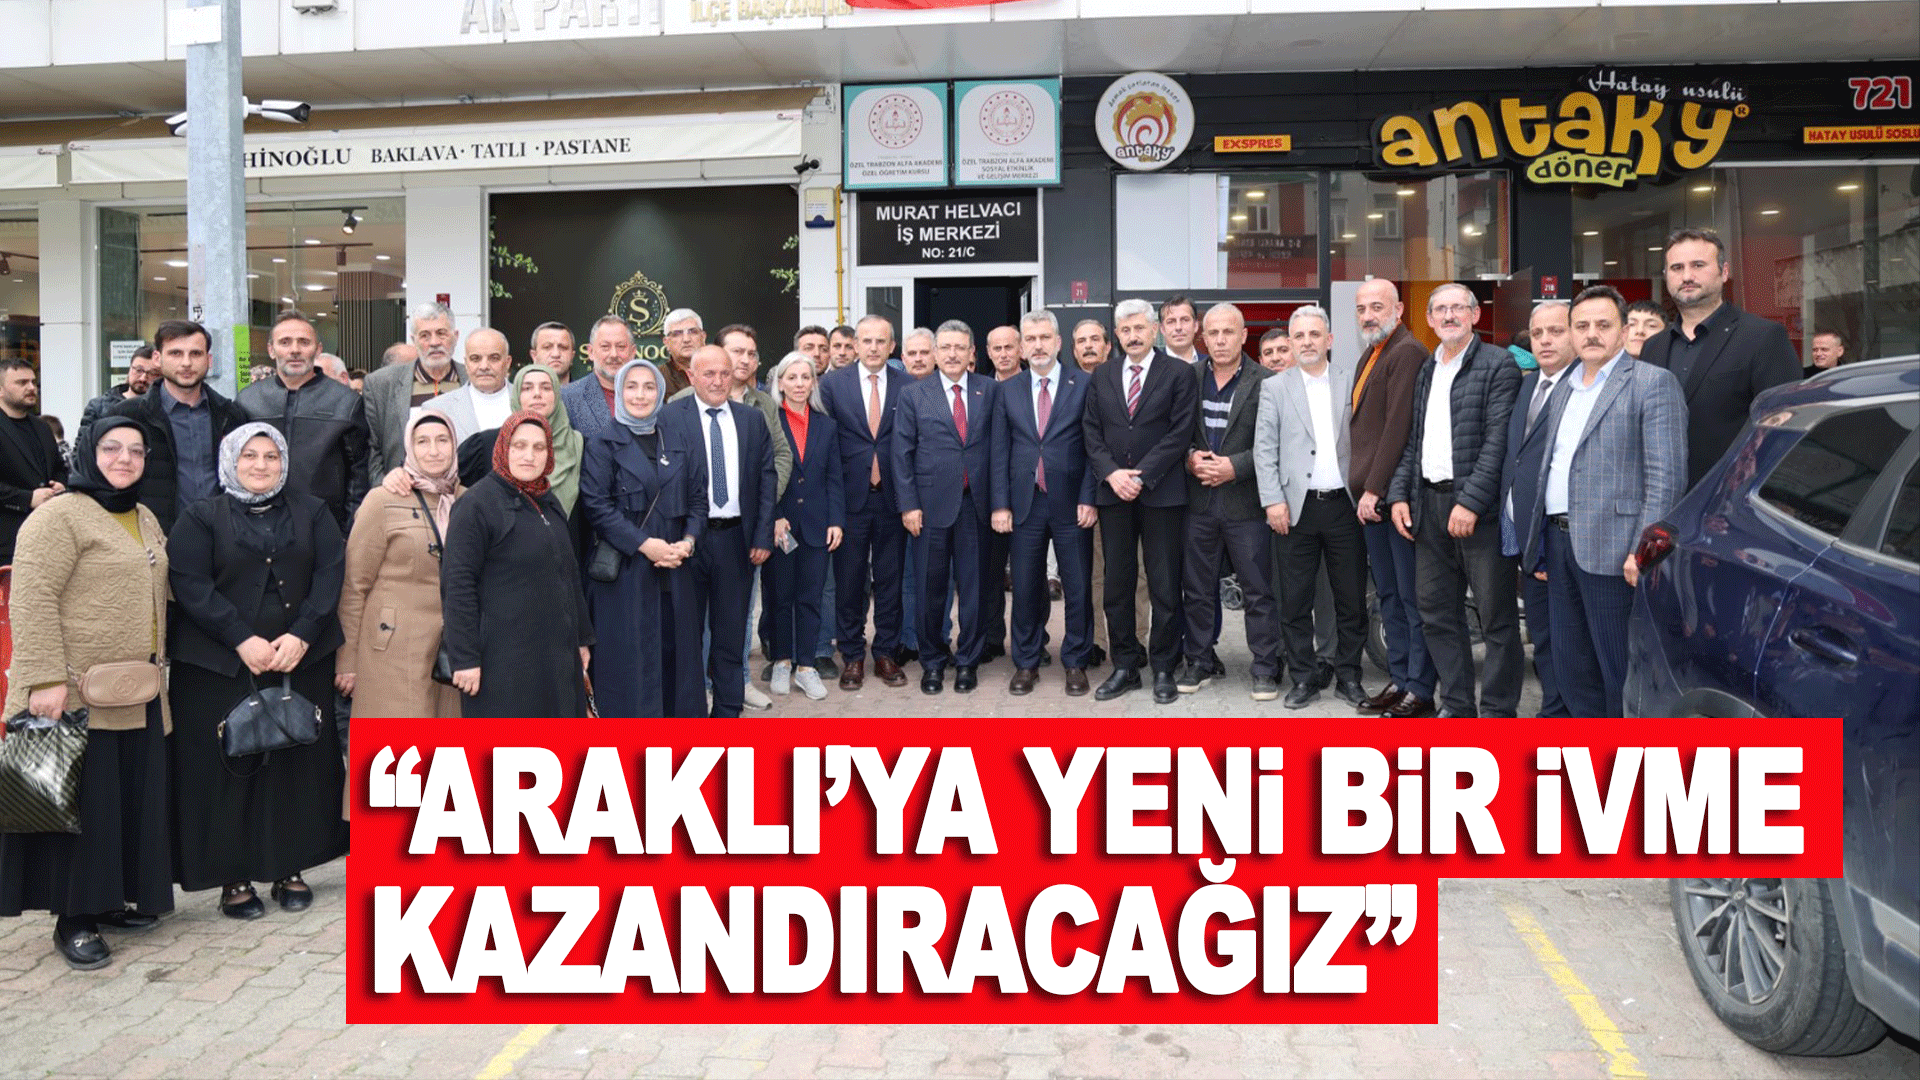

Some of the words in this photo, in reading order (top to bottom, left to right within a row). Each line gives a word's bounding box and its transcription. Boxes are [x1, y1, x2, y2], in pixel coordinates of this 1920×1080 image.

[1588, 69, 1670, 100] Hatay
[1848, 76, 1912, 110] 721
[1808, 130, 1847, 141] HATAY
[1849, 126, 1883, 140] USULÜ
[471, 142, 526, 159] TATLI
[1223, 138, 1283, 149] EXSPRES
[1534, 155, 1634, 182] döner
[876, 205, 939, 221] MURAT
[945, 202, 1021, 219] HELVACI
[897, 224, 914, 245] İŞ
[919, 221, 1000, 241] MERKEZİ
[922, 248, 945, 258] NO:
[948, 246, 976, 258] 21/C
